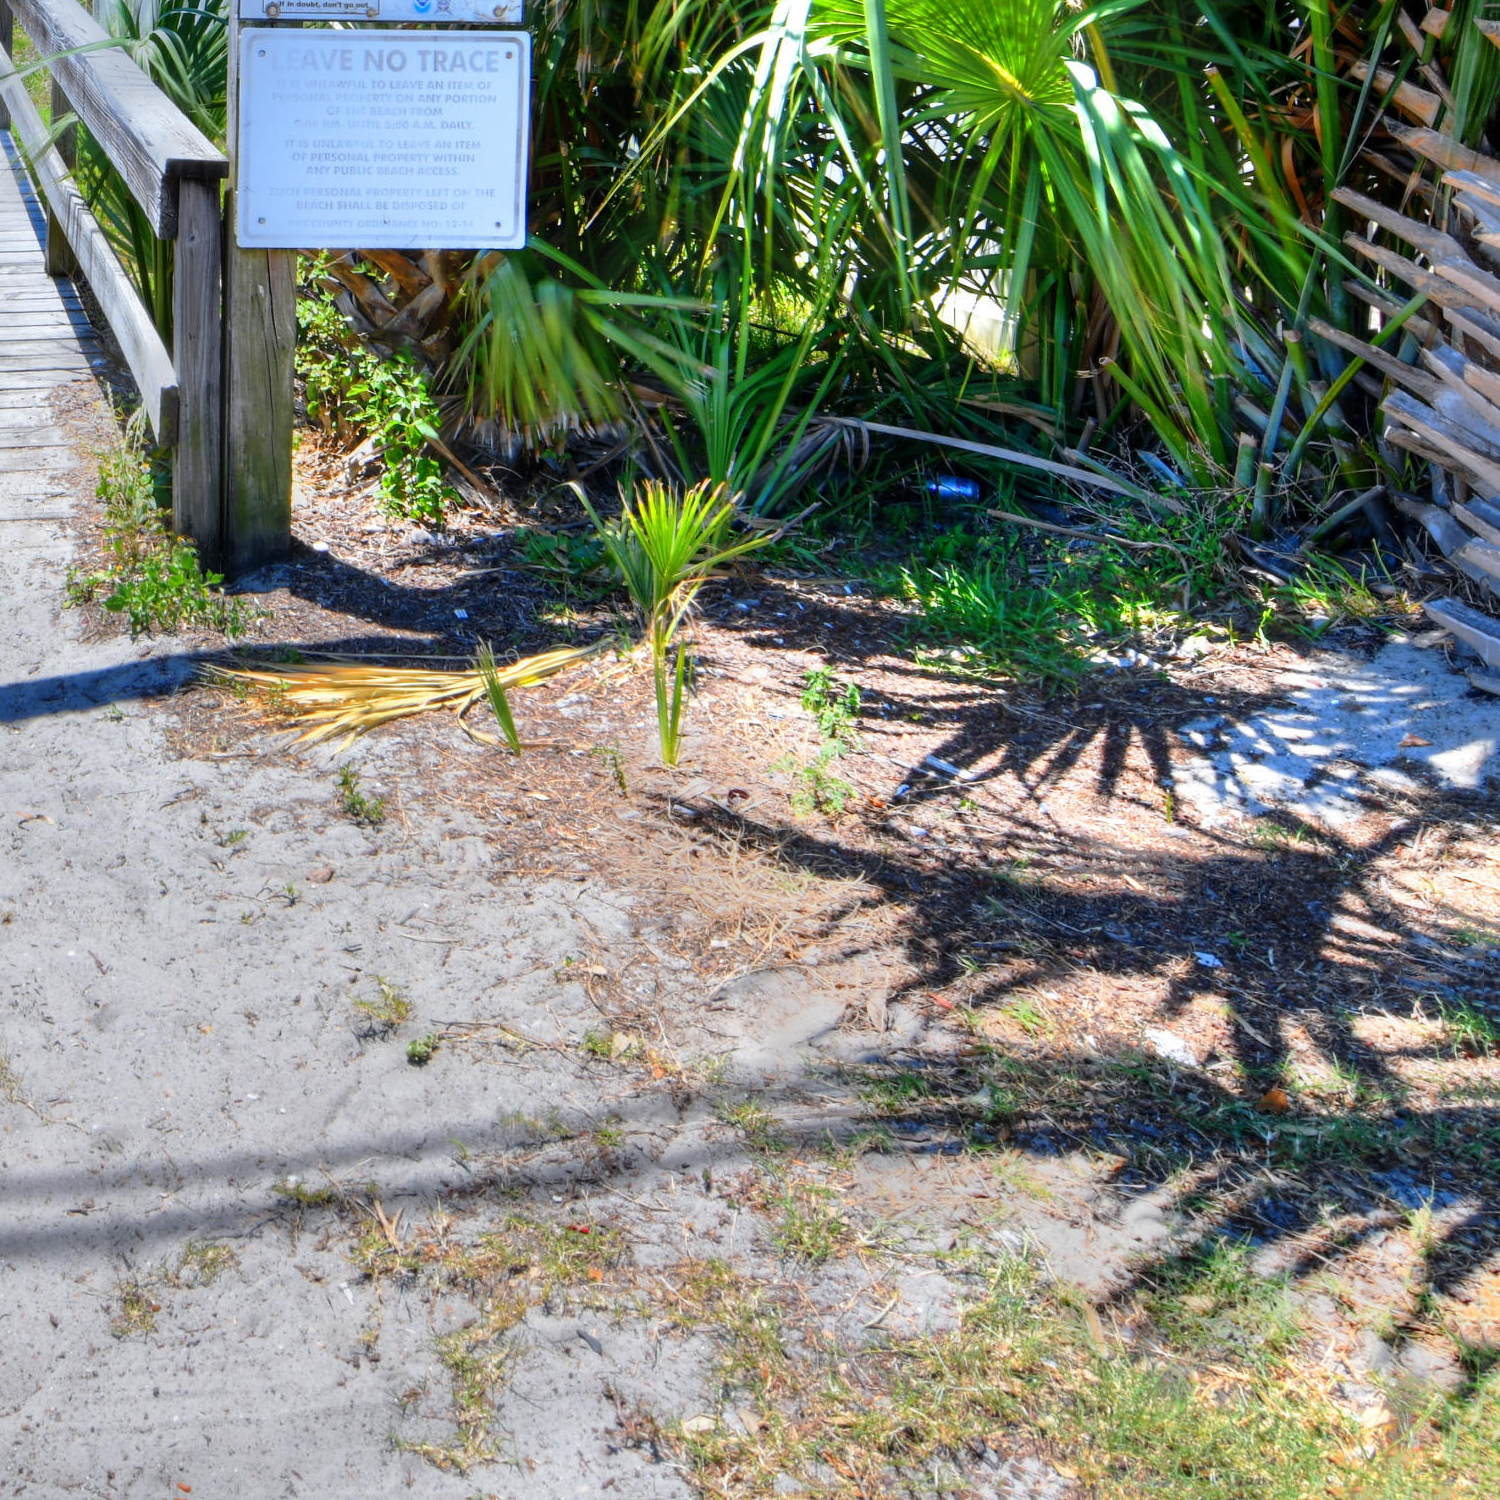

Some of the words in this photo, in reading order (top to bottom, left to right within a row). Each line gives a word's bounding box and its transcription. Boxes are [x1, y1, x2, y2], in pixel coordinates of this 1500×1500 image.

[279, 0, 285, 9] If
[287, 0, 294, 9] in
[323, 0, 342, 10] don't
[344, 0, 353, 10] go
[356, 0, 369, 10] out
[272, 50, 352, 72] LEAVE
[364, 50, 407, 73] NO
[417, 50, 498, 73] TRACE
